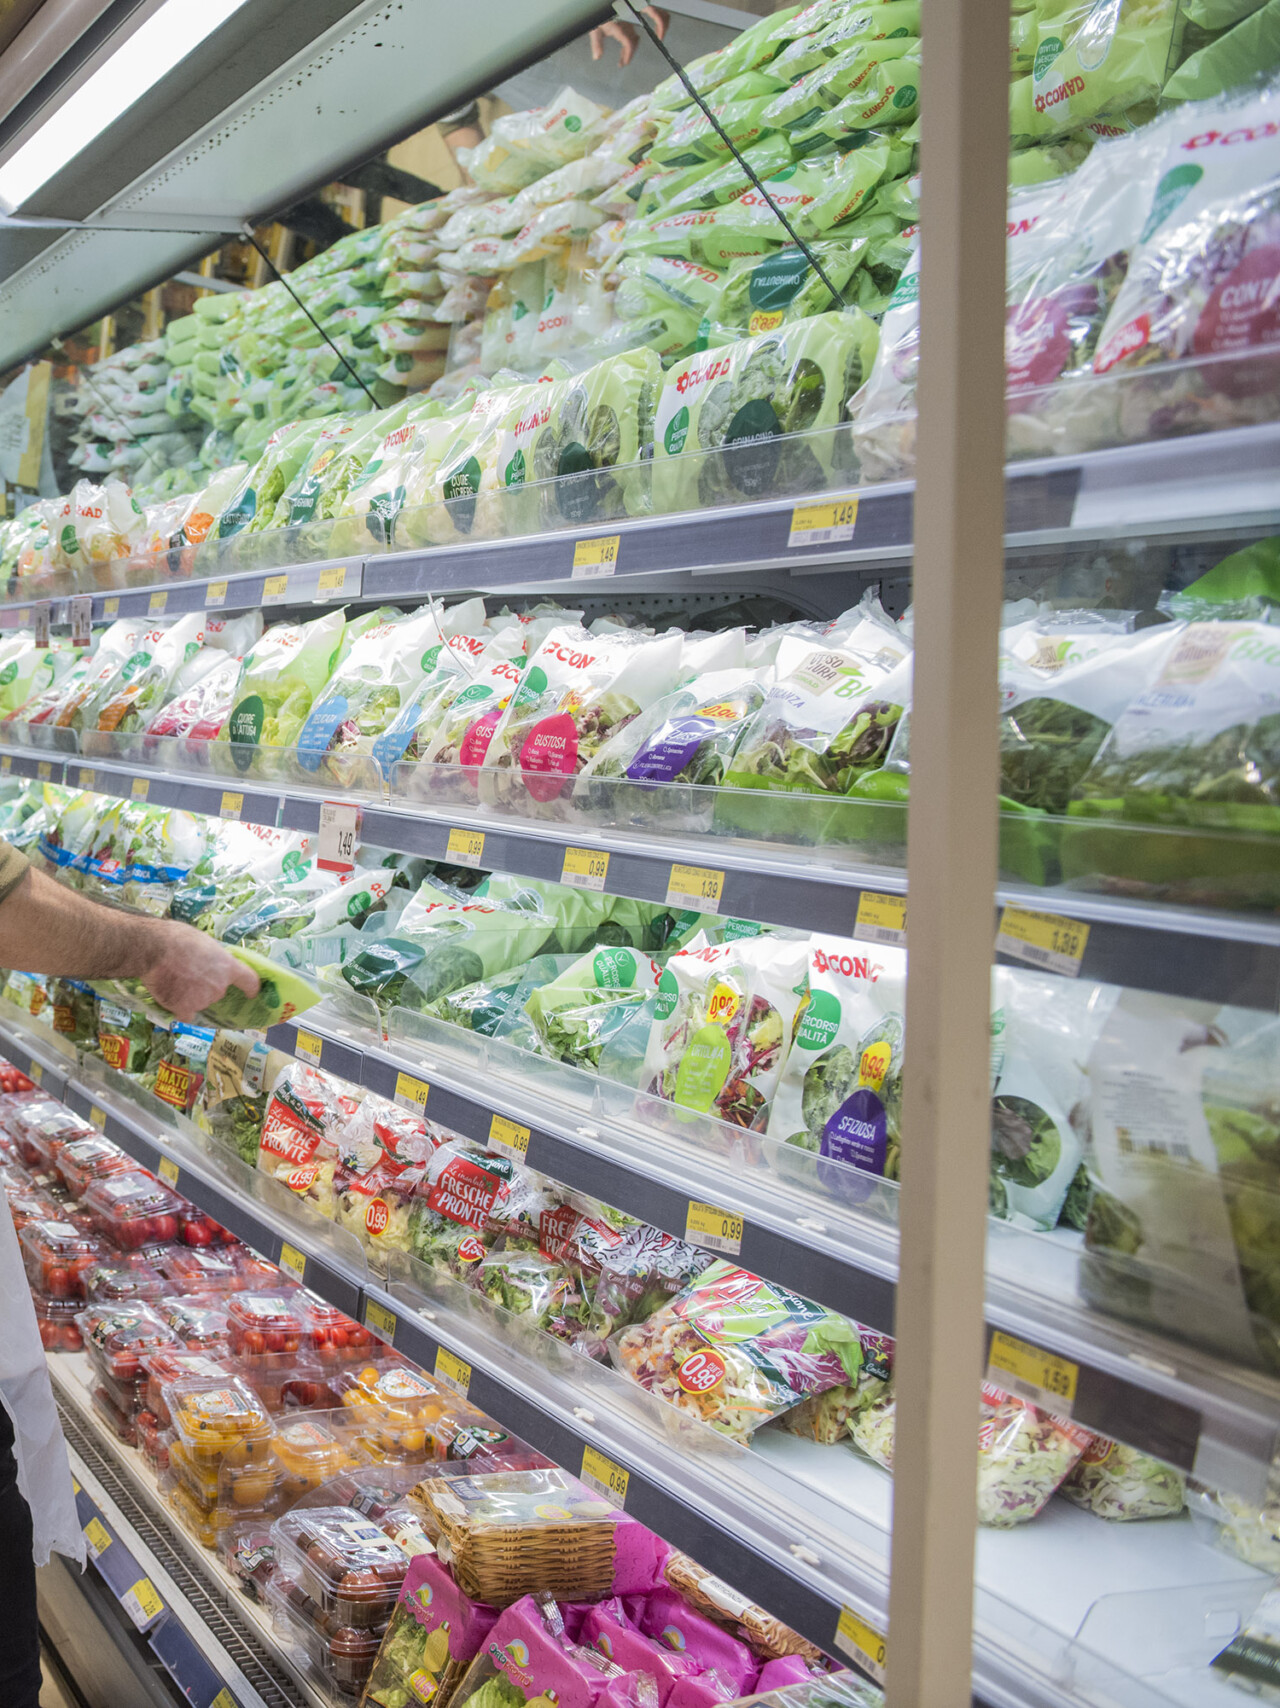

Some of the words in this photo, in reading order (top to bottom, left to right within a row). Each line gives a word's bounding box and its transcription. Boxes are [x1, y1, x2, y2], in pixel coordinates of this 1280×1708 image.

[688, 357, 731, 389] CONAD
[832, 505, 853, 528] 1,49
[600, 546, 615, 564] 1,49
[237, 712, 256, 724] CUORE
[534, 733, 567, 750] GUSTOSA
[338, 831, 353, 857] 1,49
[468, 839, 482, 855] 0,99
[588, 860, 606, 878] 0,99
[701, 881, 718, 899] 1,39
[727, 922, 759, 936] PERCORSO
[1051, 929, 1079, 958] 1,39
[415, 1088, 426, 1105] 1,49
[837, 1115, 877, 1141] SFIZIOSA
[513, 1135, 528, 1153] 0,99
[288, 1170, 315, 1186] 0,99
[440, 1172, 494, 1211] FRESCHE
[438, 1194, 488, 1229] PRONTE
[366, 1208, 387, 1235] 0,99
[721, 1219, 741, 1242] 0,99
[457, 1369, 471, 1387] 0,99
[681, 1353, 716, 1391] 0,99
[706, 1361, 724, 1378] euro
[609, 1472, 627, 1496] 0,99
